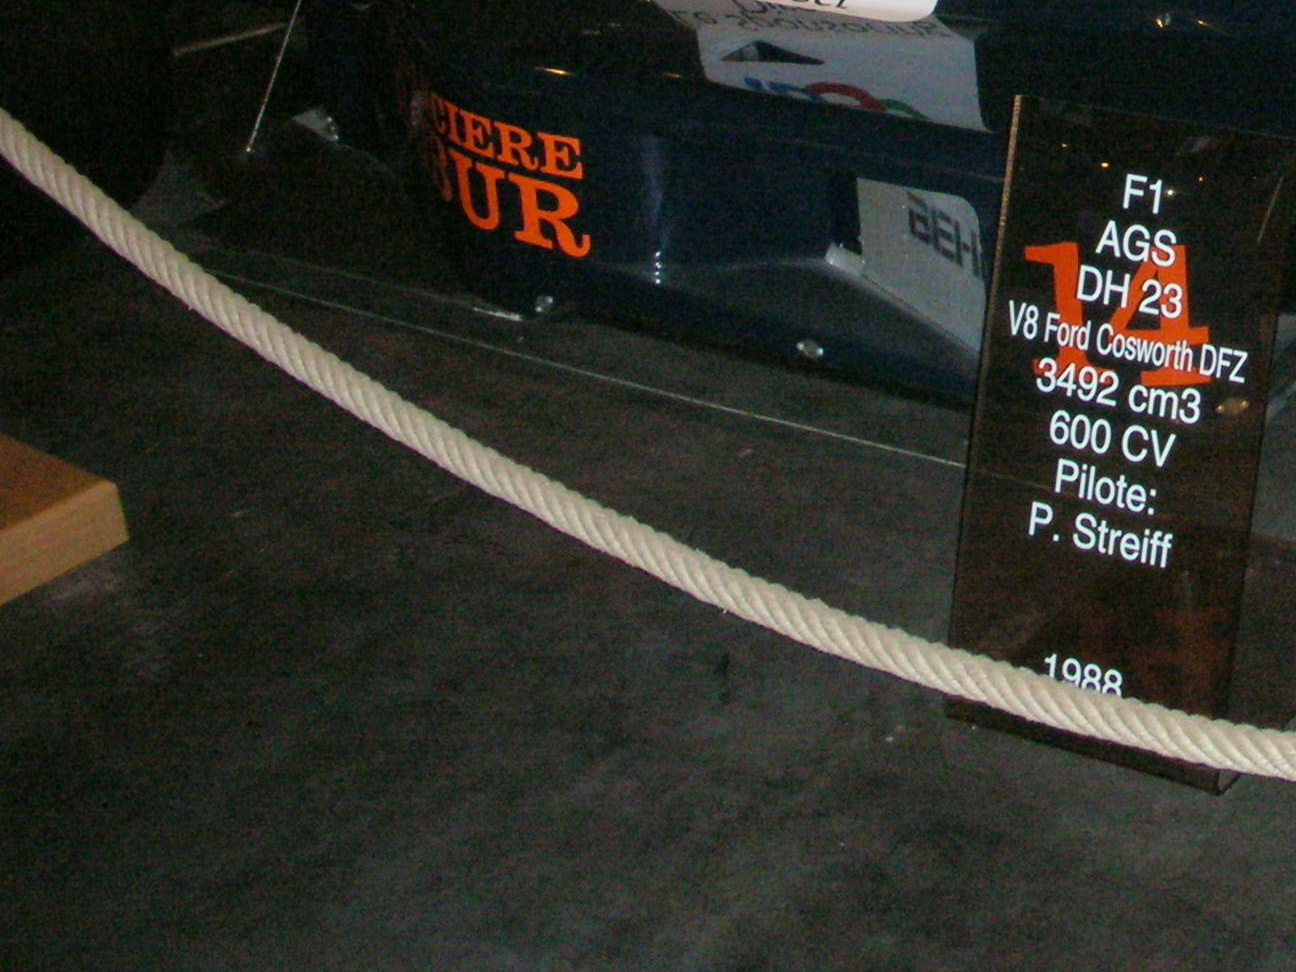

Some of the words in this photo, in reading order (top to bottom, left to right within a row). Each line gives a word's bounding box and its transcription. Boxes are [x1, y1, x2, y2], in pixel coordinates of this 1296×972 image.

[1122, 172, 1163, 215] F1
[1095, 219, 1177, 268] AGS
[1076, 263, 1131, 309] DH
[1137, 278, 1184, 319] 23
[1008, 299, 1039, 340] V8
[1044, 311, 1092, 351] Ford
[1095, 322, 1194, 373] Cosworth
[1198, 343, 1249, 384] DFZ
[1035, 356, 1120, 407] 3492
[1127, 383, 1202, 425] cm3
[1049, 409, 1112, 455] 600
[1121, 424, 1177, 468] CV
[1054, 457, 1158, 516] Pilote:
[1028, 500, 1061, 543] P.
[1071, 511, 1174, 569] Streiff
[1043, 653, 1123, 698] 1988
